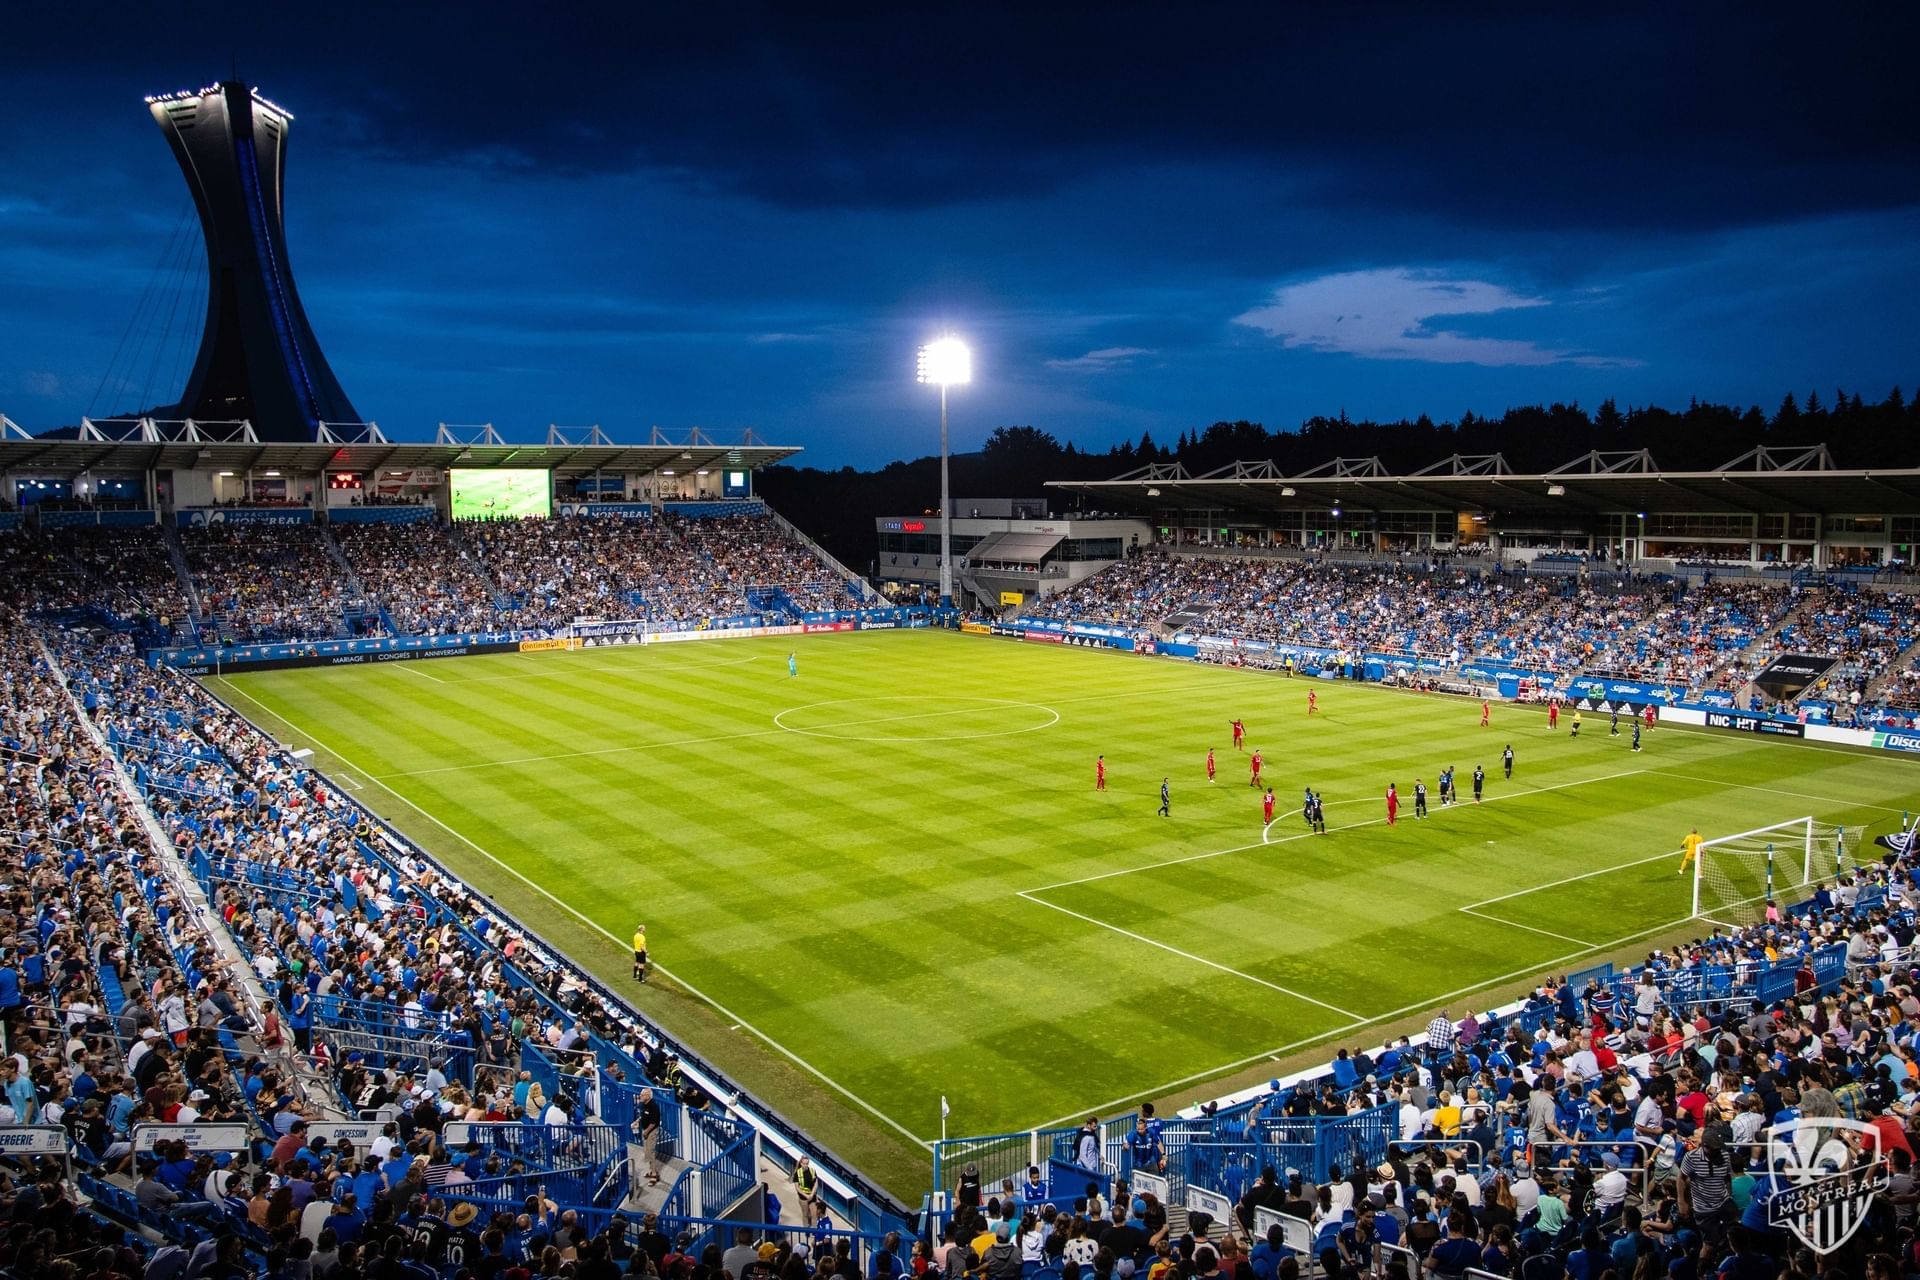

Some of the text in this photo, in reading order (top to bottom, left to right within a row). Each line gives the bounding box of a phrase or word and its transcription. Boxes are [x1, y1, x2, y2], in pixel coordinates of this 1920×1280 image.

[332, 655, 364, 664] MARIAGE
[423, 648, 467, 658] ANNIVERSAIRE
[1709, 714, 1730, 727] NIC
[0, 1134, 34, 1146] ERGERIE
[334, 1129, 368, 1138] CONCESSION
[446, 1244, 464, 1264] 10
